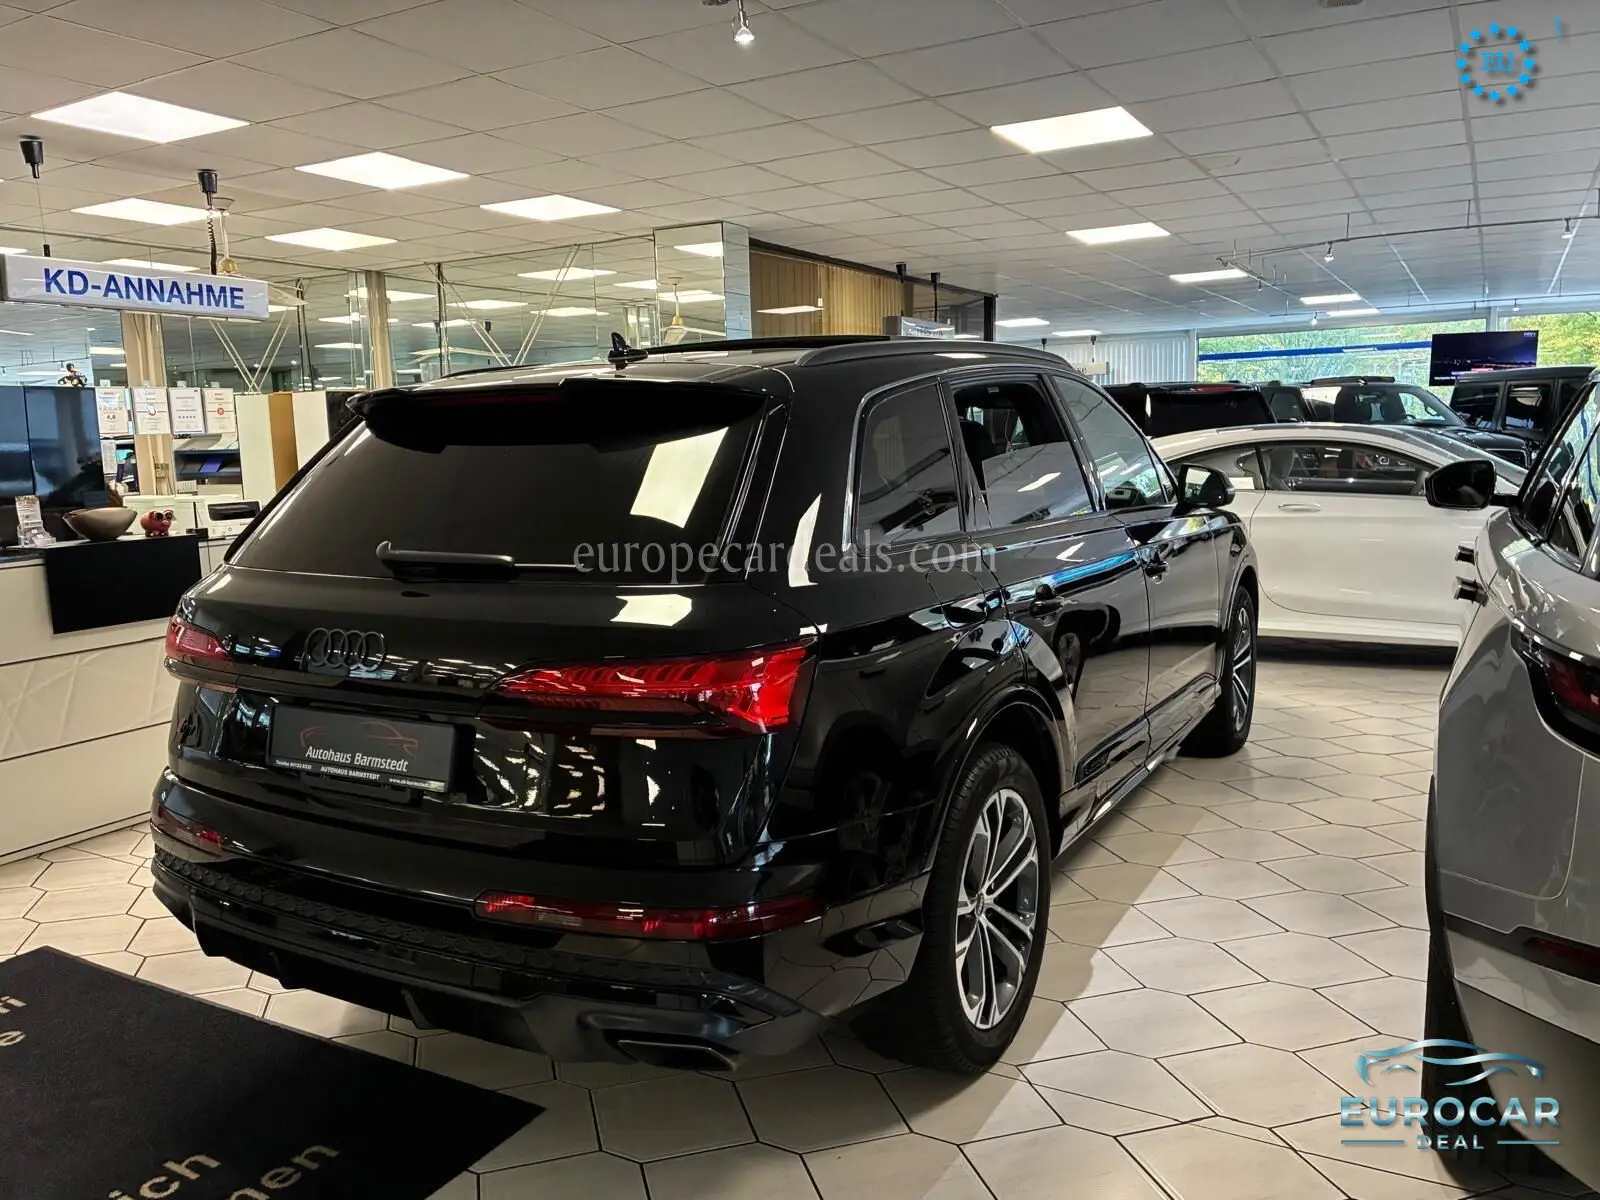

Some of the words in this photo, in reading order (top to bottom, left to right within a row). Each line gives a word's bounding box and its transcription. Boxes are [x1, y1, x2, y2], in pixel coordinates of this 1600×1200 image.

[43, 267, 246, 310] KD-ANNAHME
[305, 745, 352, 764] Autohaus
[353, 752, 409, 772] Barmstedt
[320, 765, 348, 776] AUTOHAUS
[348, 769, 381, 780] BARMSTEDT
